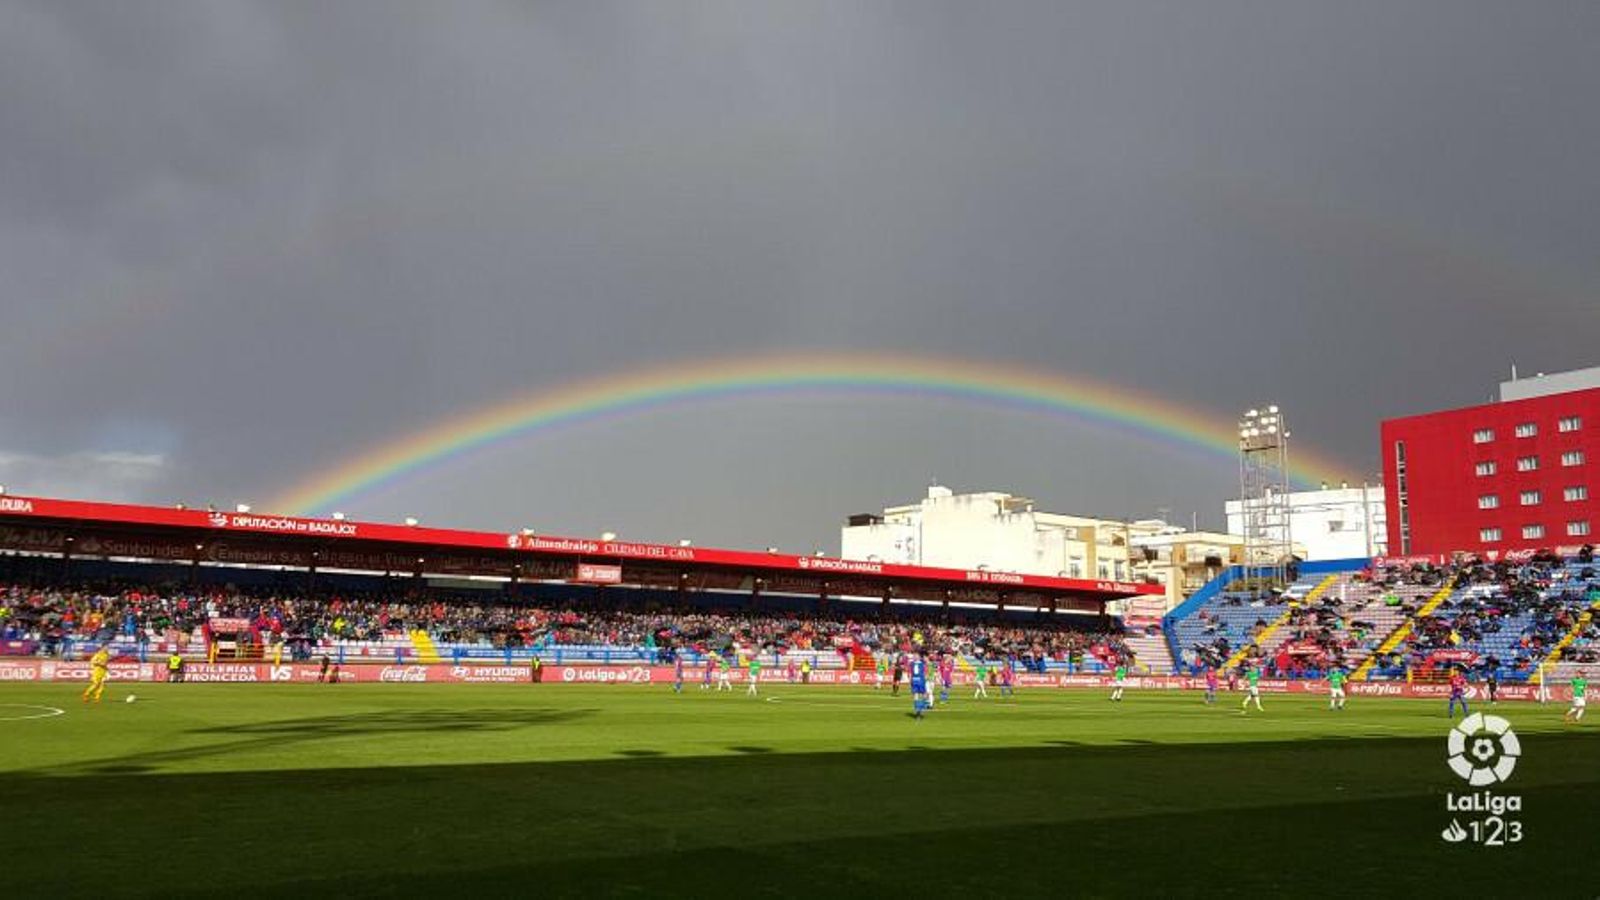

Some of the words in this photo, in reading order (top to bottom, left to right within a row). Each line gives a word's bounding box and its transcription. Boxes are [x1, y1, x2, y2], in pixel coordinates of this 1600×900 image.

[0, 498, 33, 512] DURA
[232, 517, 296, 530] DIPUTACIÓN
[309, 522, 356, 534] BADAJOZ
[102, 539, 185, 557] Santander
[528, 538, 599, 552] Almendralejo
[604, 543, 646, 556] CIUDAD
[647, 547, 669, 557] DEL
[270, 666, 292, 680] VS
[474, 668, 529, 677] HYUNDAI
[579, 667, 615, 680] LaLiga
